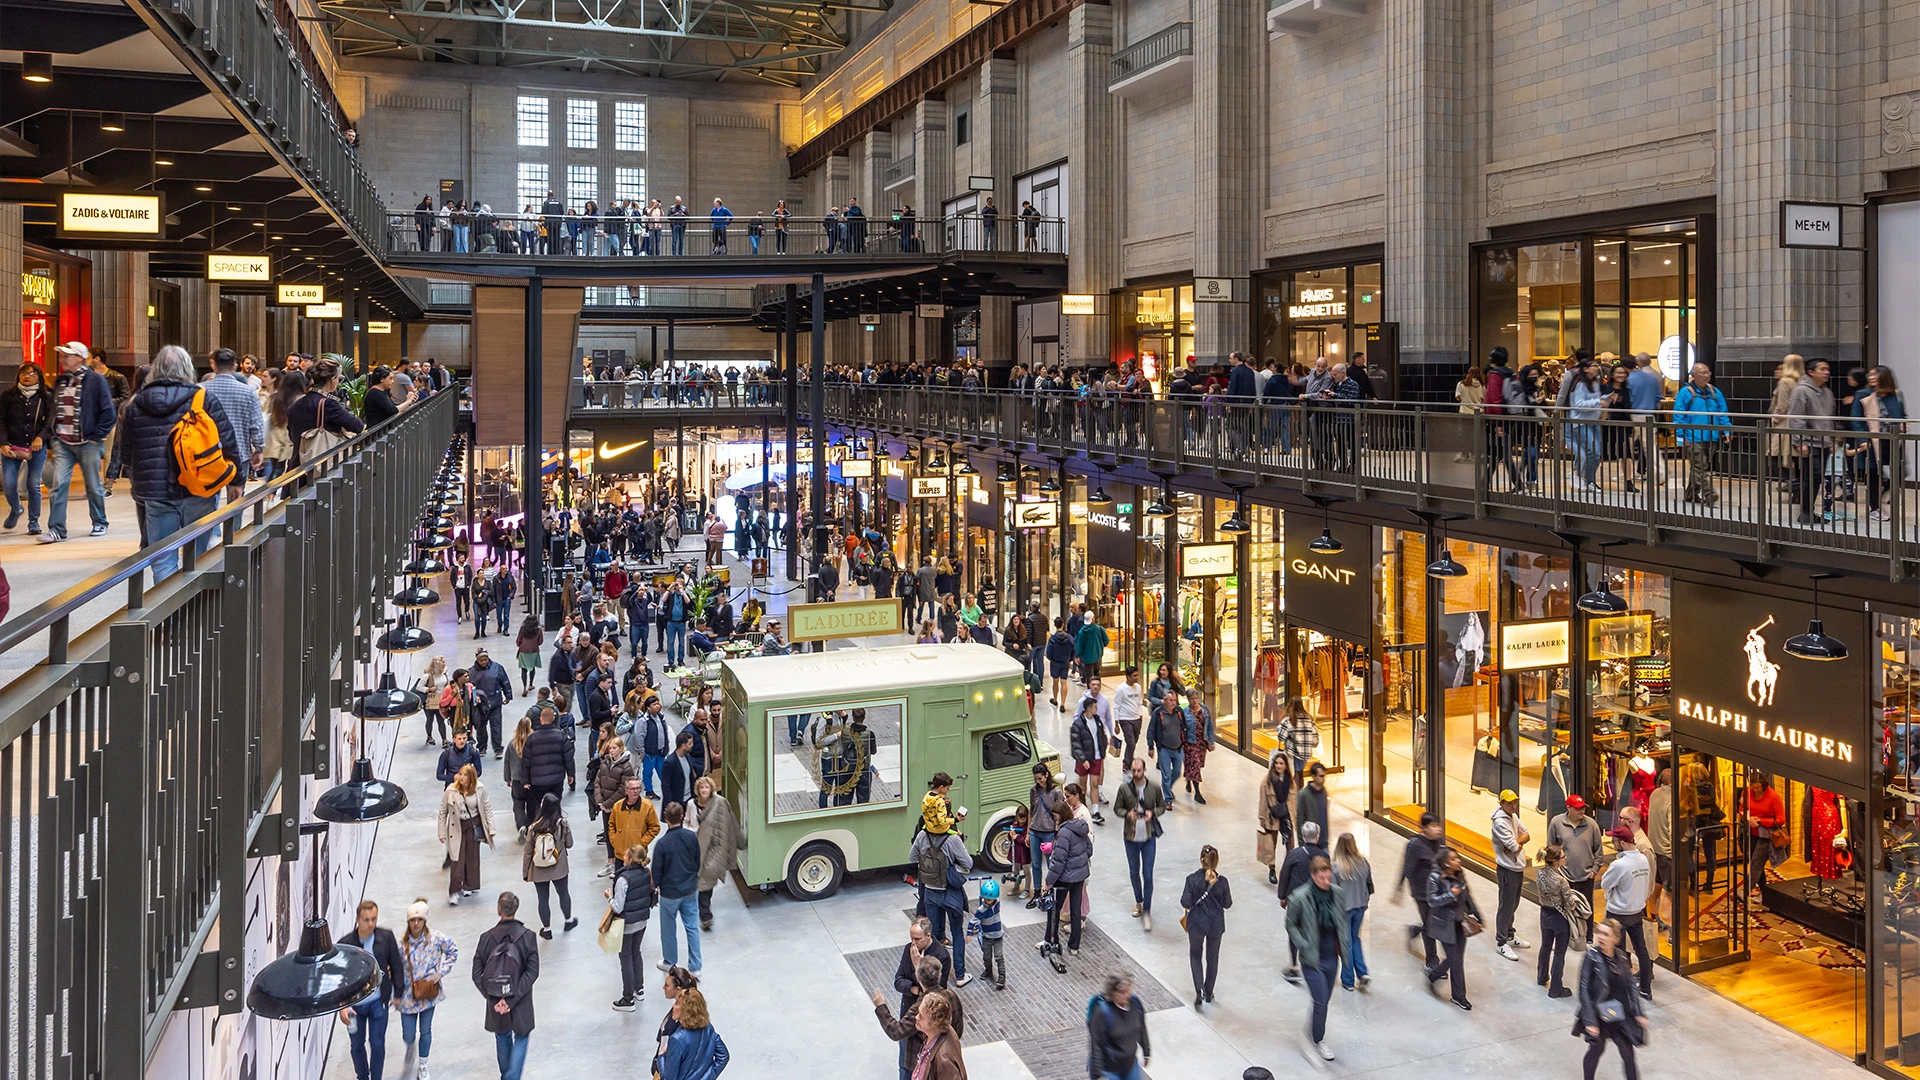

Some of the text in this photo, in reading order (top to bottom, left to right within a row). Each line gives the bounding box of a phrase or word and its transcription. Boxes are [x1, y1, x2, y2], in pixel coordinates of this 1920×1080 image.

[1795, 219, 1830, 231] ME+EM
[1301, 288, 1334, 303] PARIS
[1289, 302, 1347, 318] BAGUETTE
[918, 487, 941, 495] KOOPLES
[1088, 511, 1117, 529] LACOSTE
[1188, 555, 1229, 564] GANT
[1291, 558, 1356, 585] GANT
[803, 609, 890, 631] LADURÉE
[1506, 638, 1567, 651] RALPH LAUREN
[1678, 697, 1853, 763] RALPH LAUREN
